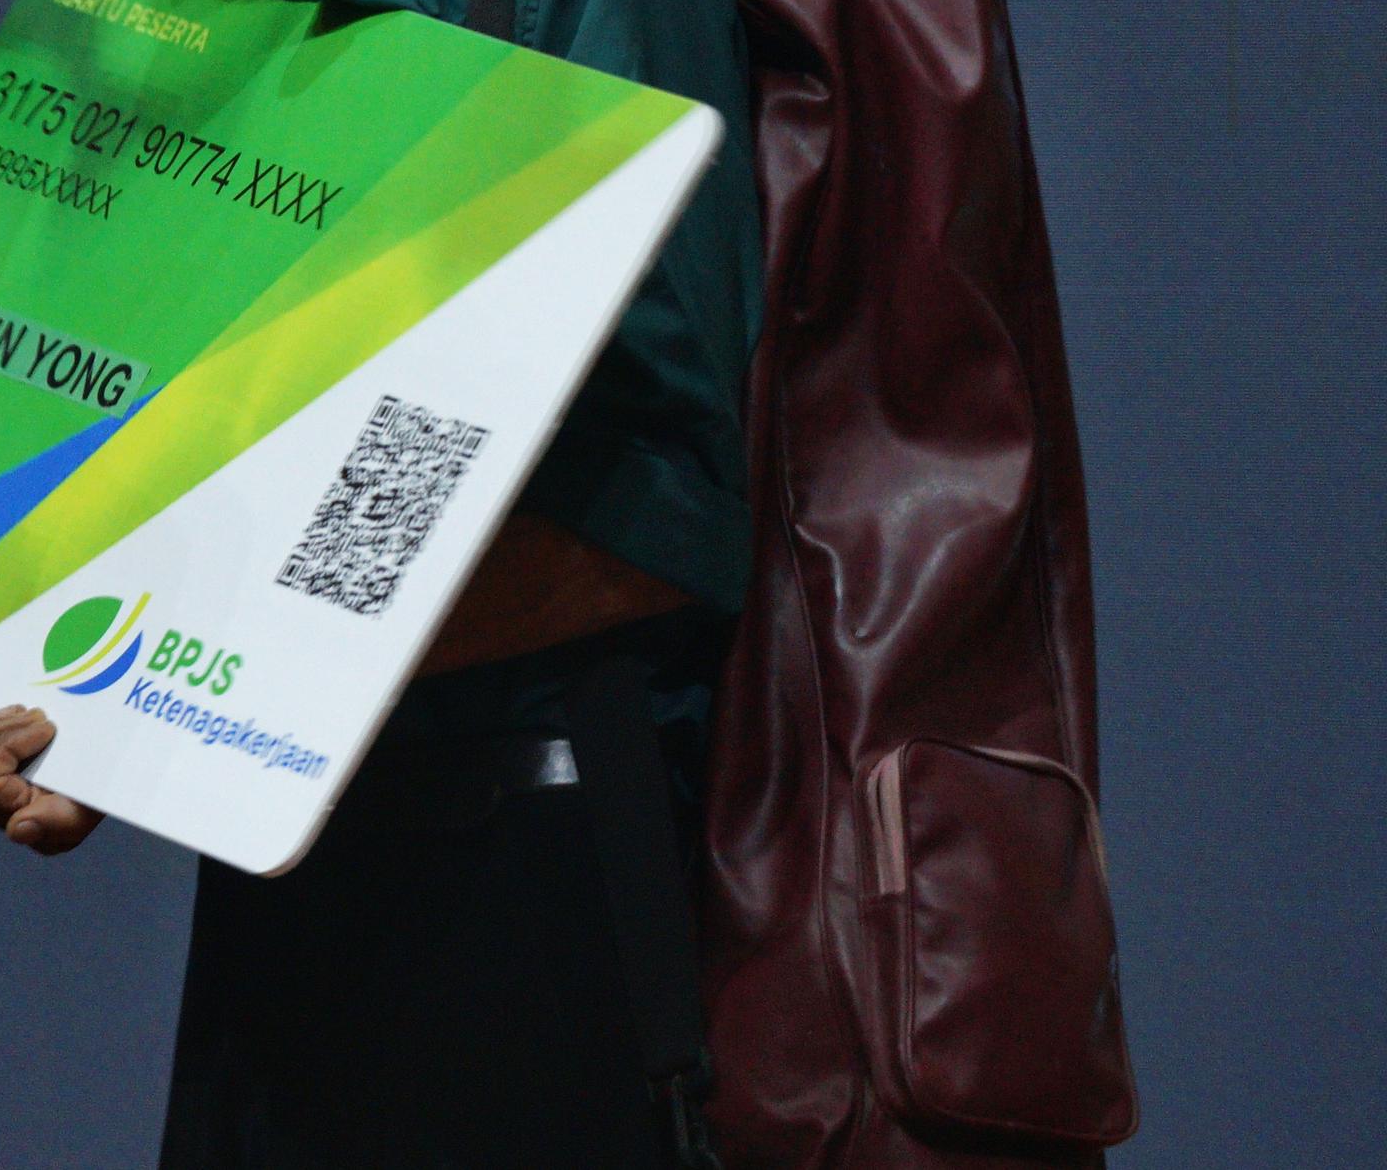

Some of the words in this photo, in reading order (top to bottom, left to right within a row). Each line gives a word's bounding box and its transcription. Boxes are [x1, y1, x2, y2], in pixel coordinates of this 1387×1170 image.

[123, 4, 211, 55] PESERTA
[70, 101, 139, 159] 021
[134, 124, 242, 196] 90774
[232, 158, 345, 230] XXXX
[26, 332, 133, 409] YONG
[146, 628, 244, 697] BPJS
[123, 676, 331, 781] Ketenagakerjaan
